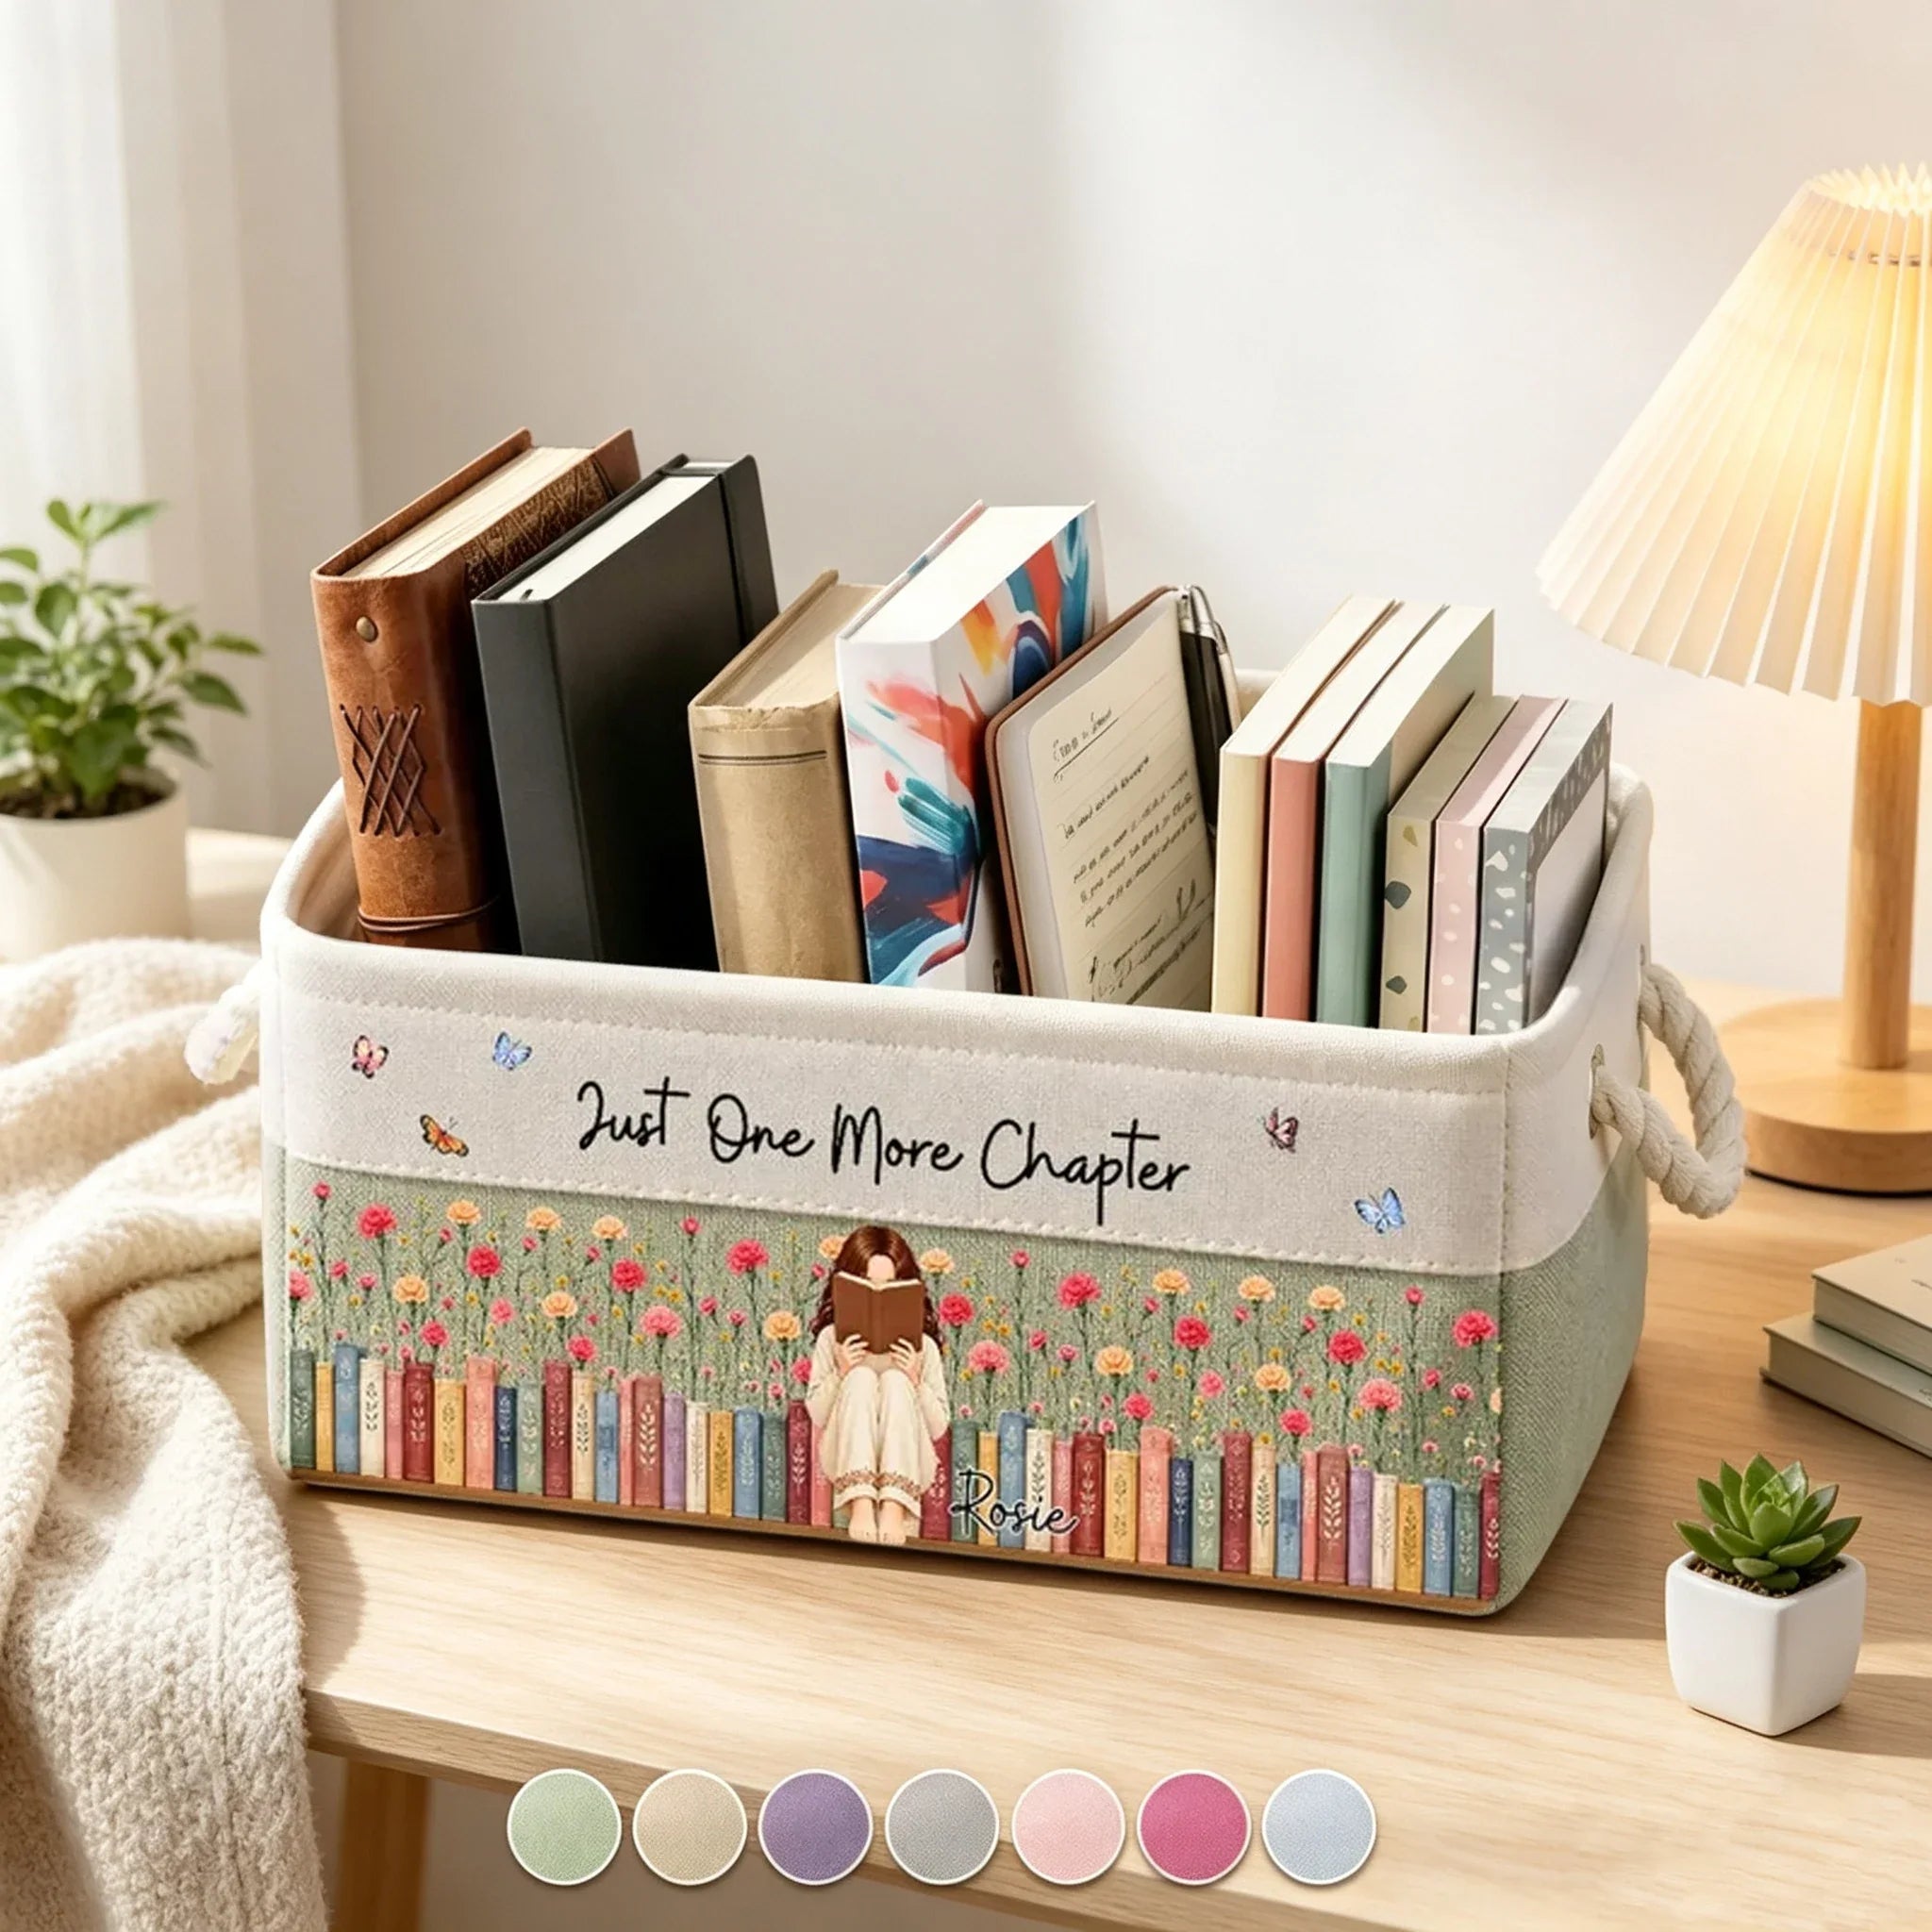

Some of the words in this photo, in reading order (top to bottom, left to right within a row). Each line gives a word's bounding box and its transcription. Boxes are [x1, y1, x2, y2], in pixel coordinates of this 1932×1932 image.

[577, 1076, 691, 1150] Just
[708, 1093, 814, 1162] One
[831, 1104, 963, 1184] More
[981, 1119, 1191, 1225] Chapter
[950, 1469, 1077, 1535] Rosie
